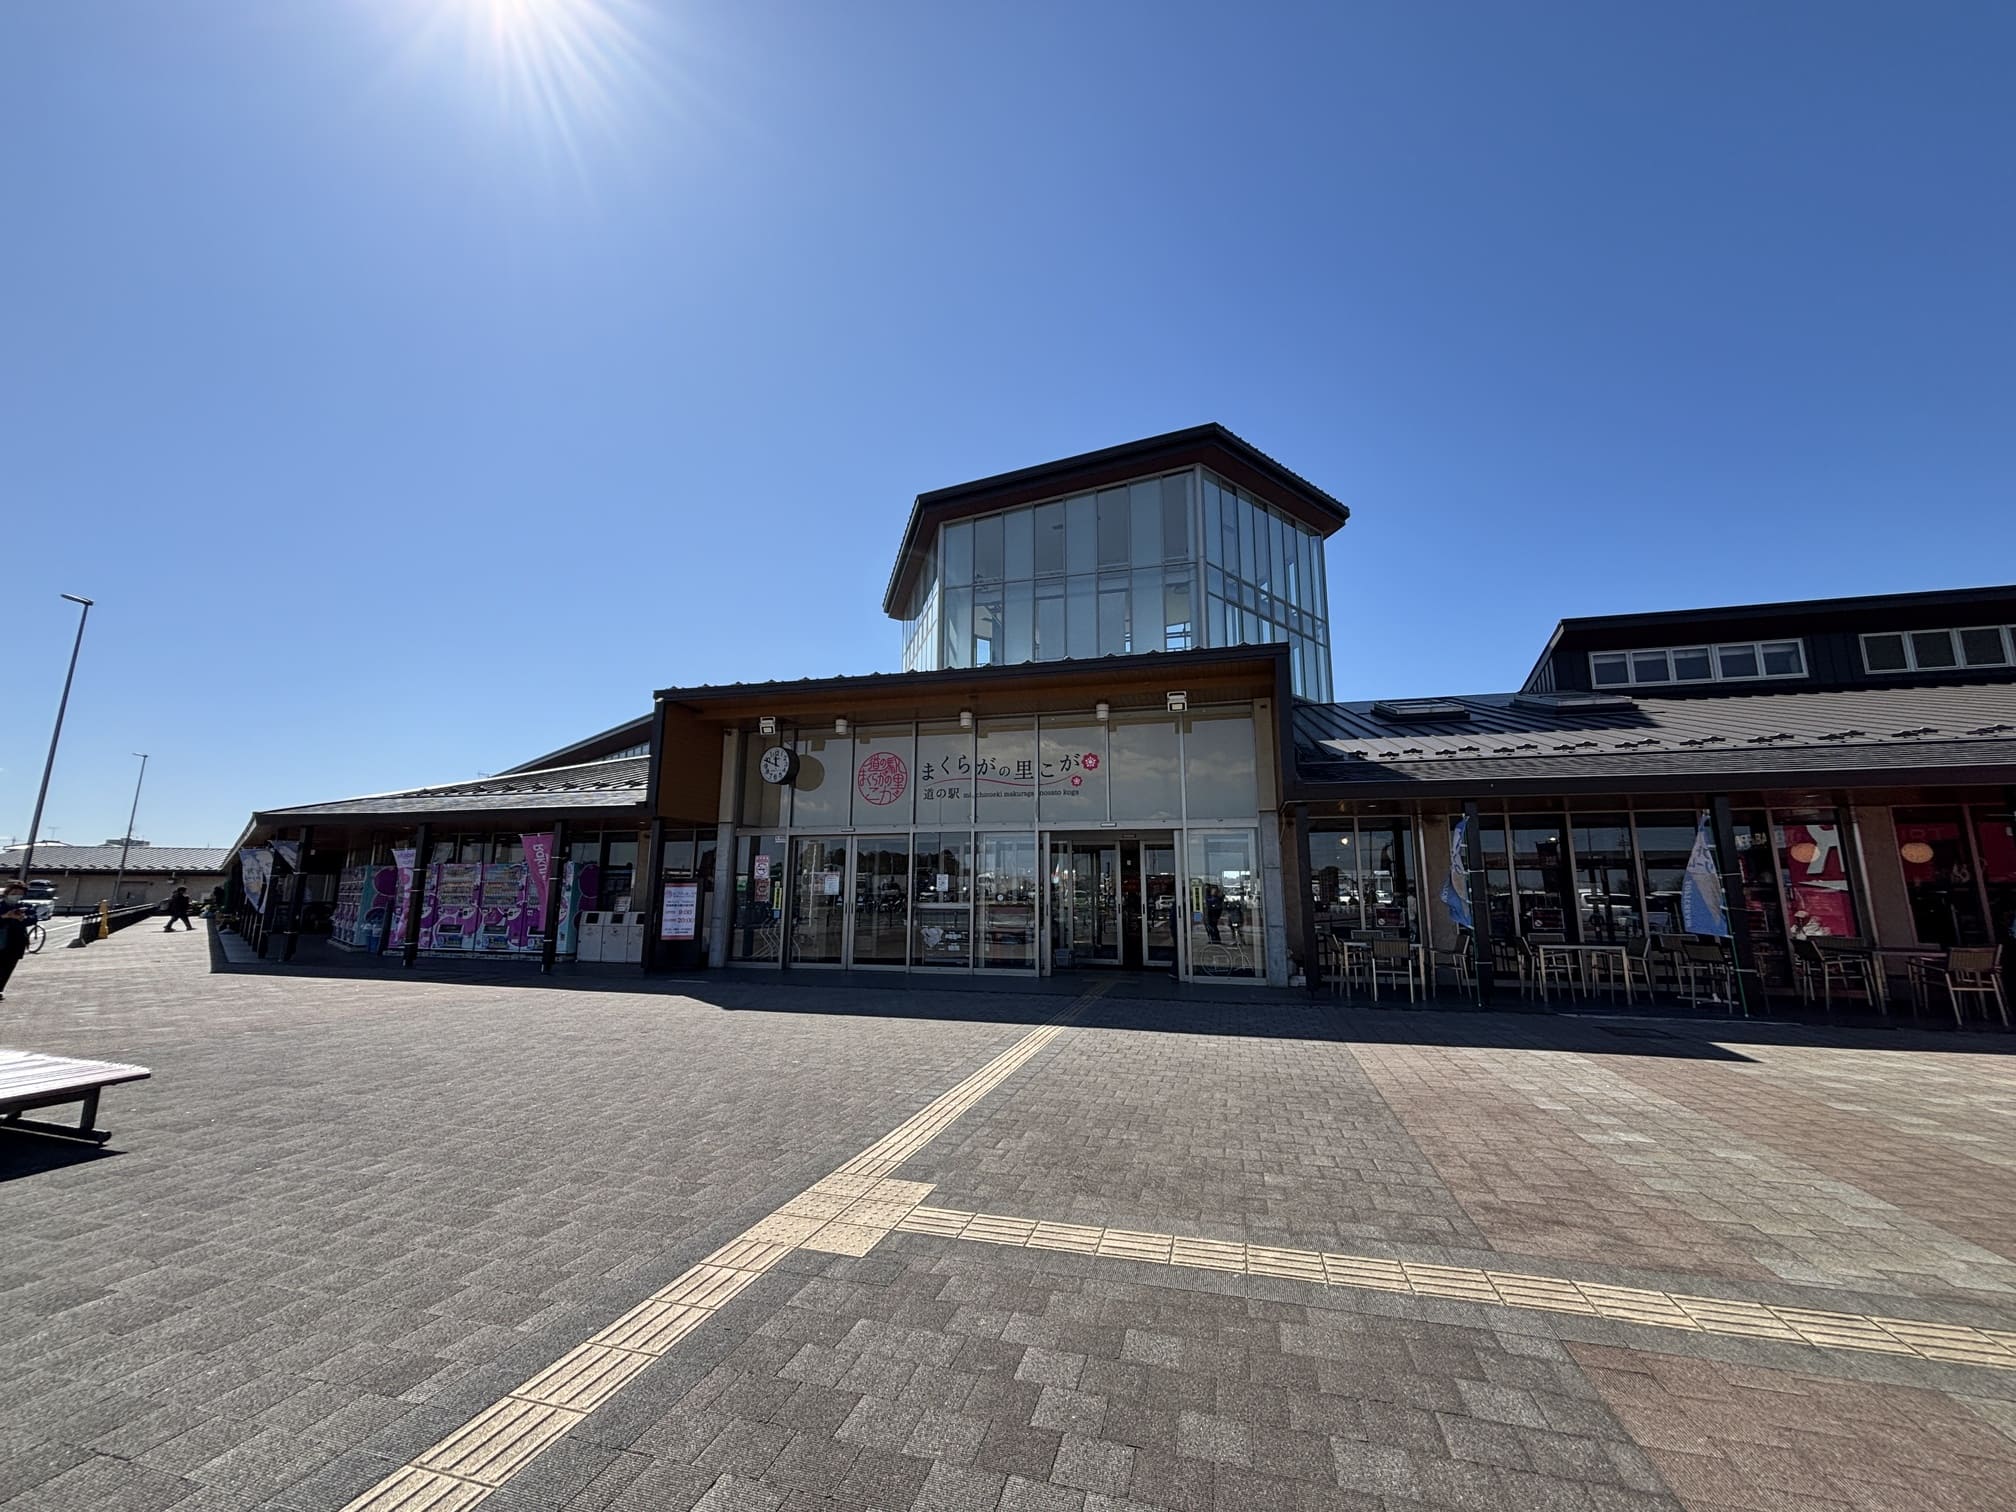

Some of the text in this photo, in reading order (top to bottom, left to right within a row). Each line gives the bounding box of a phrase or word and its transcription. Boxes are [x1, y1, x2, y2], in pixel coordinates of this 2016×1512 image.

[922, 753, 1081, 780] まくらがの里こが
[923, 787, 960, 800] 道の駅
